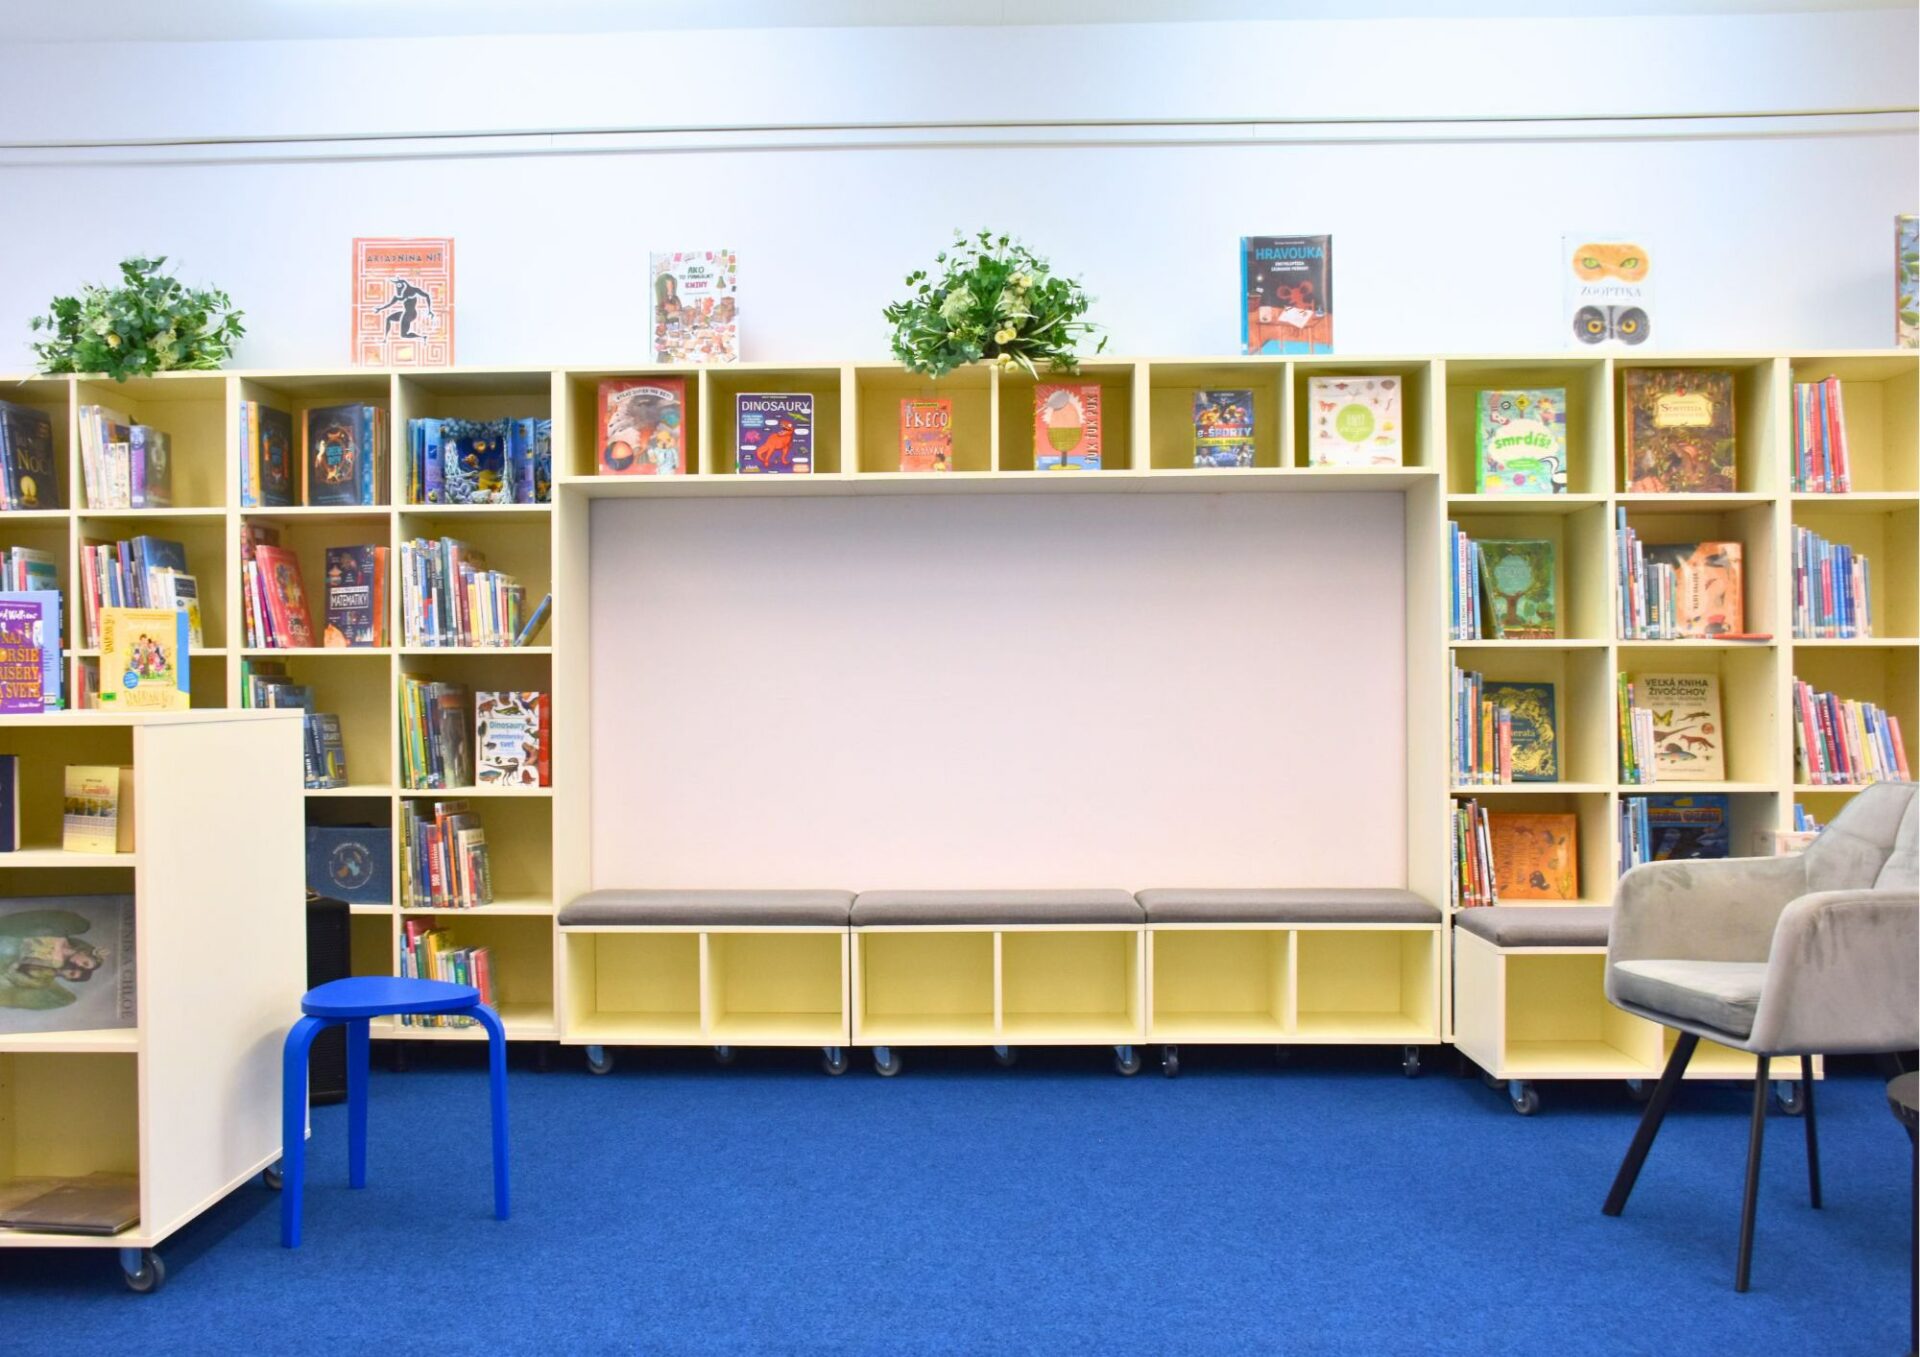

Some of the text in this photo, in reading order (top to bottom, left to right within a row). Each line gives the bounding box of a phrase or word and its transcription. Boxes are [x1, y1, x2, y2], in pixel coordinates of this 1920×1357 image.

[1255, 246, 1323, 260] HRAVOUKA
[688, 266, 705, 274] AKO
[1580, 286, 1642, 297] ZOOPTIKA
[741, 401, 810, 412] DINOSAURY
[331, 593, 368, 607] MATEMATIKY
[1677, 679, 1708, 687] KNIHA
[1648, 687, 1706, 696] ŽIVOČÍCHOV
[489, 721, 525, 730] Dinosaury
